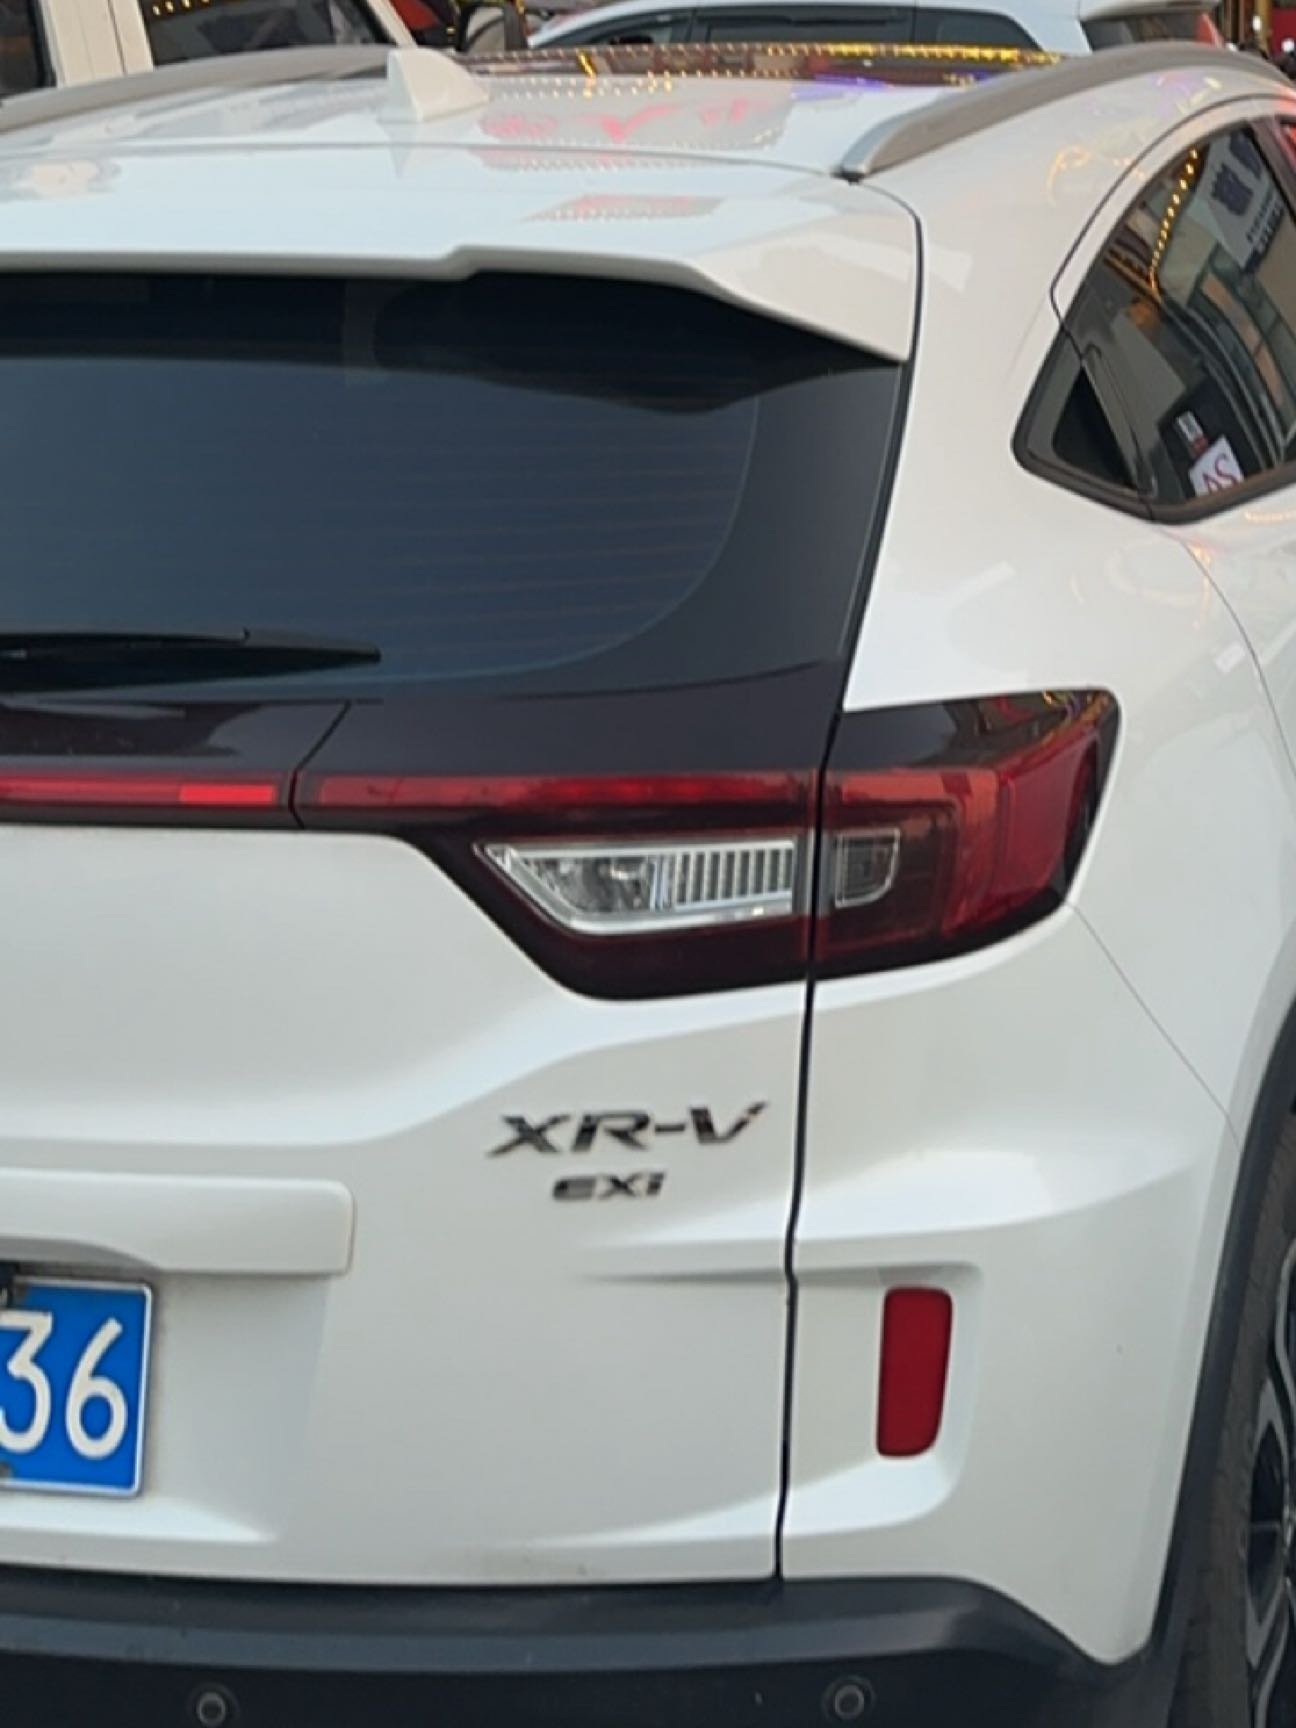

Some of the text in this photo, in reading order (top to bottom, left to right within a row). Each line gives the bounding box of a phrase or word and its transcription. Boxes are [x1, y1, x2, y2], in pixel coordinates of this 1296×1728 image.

[487, 1101, 768, 1157] XR-V
[551, 1171, 665, 1202] EXi
[0, 1311, 128, 1460] 36
